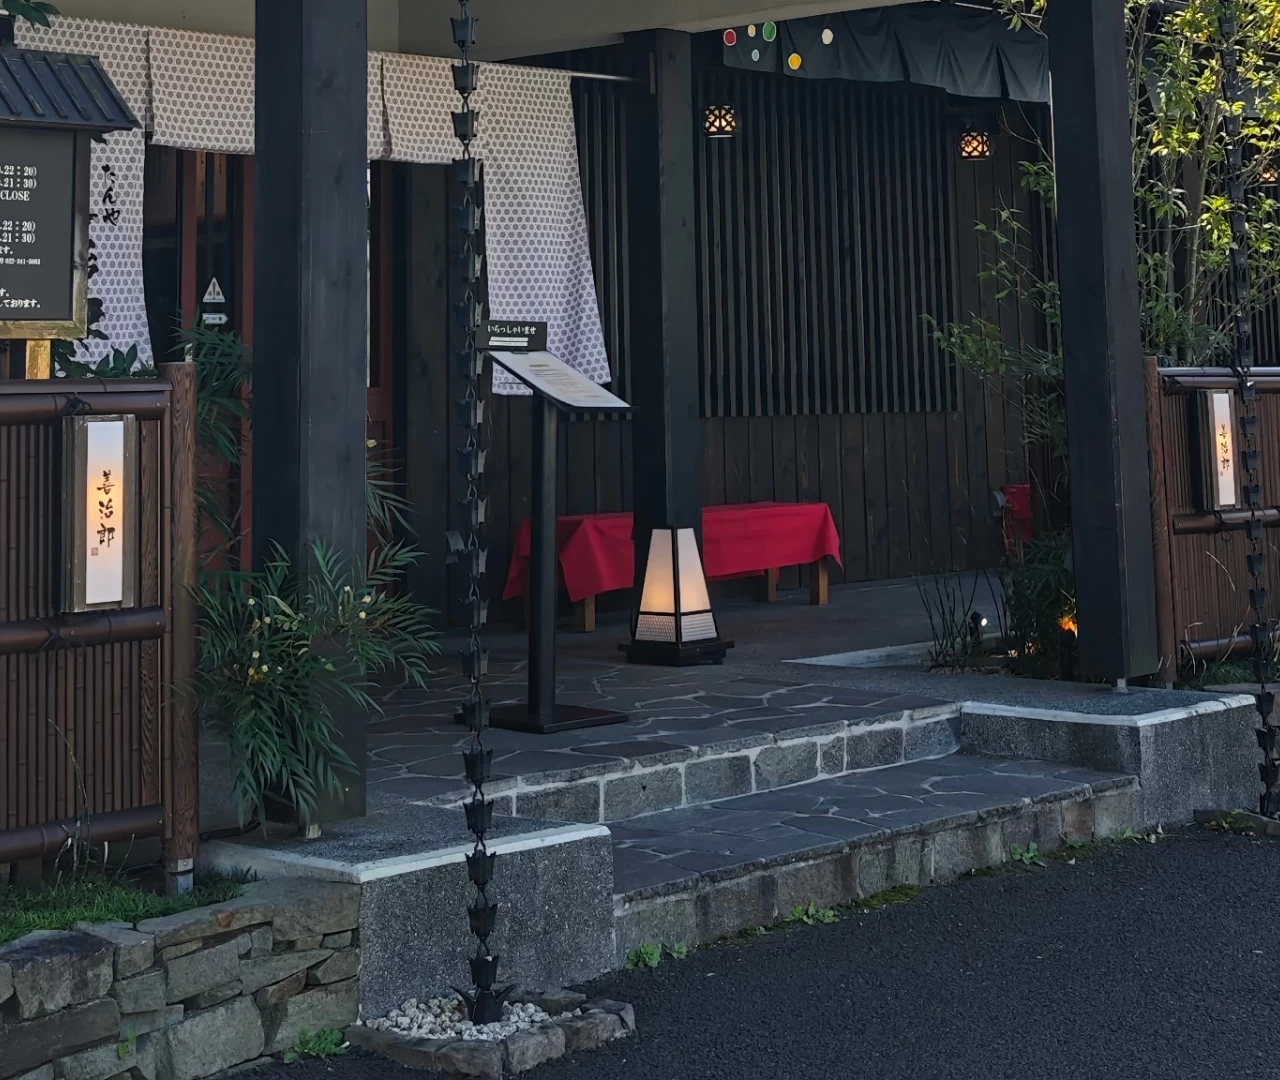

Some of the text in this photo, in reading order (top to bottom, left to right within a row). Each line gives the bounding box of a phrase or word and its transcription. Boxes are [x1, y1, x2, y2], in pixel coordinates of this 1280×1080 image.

[0, 190, 30, 202] CLOSE
[101, 163, 121, 227] たんや
[487, 324, 537, 335] いらっしゃいませ
[96, 469, 116, 548] 善治郎
